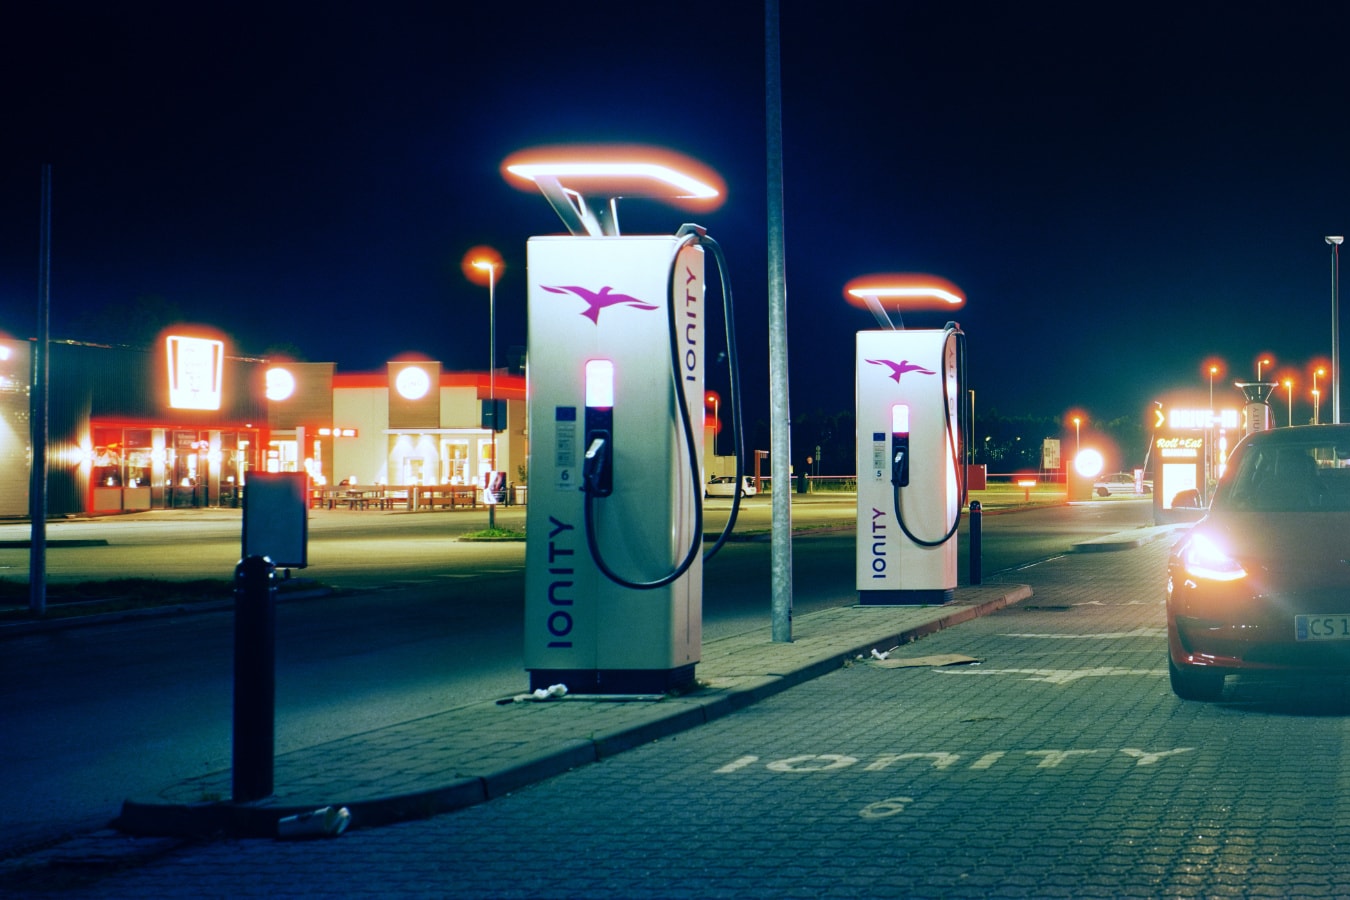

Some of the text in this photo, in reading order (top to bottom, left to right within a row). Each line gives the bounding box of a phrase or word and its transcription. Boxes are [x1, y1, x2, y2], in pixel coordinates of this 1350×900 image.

[684, 265, 698, 382] IONITY
[1168, 408, 1239, 429] DRIVE-IN
[561, 469, 569, 481] 6
[872, 507, 887, 579] IONITY
[546, 515, 575, 649] IONITY
[1310, 618, 1335, 636] CS
[713, 747, 1196, 773] IONITY
[858, 796, 913, 819] 6
